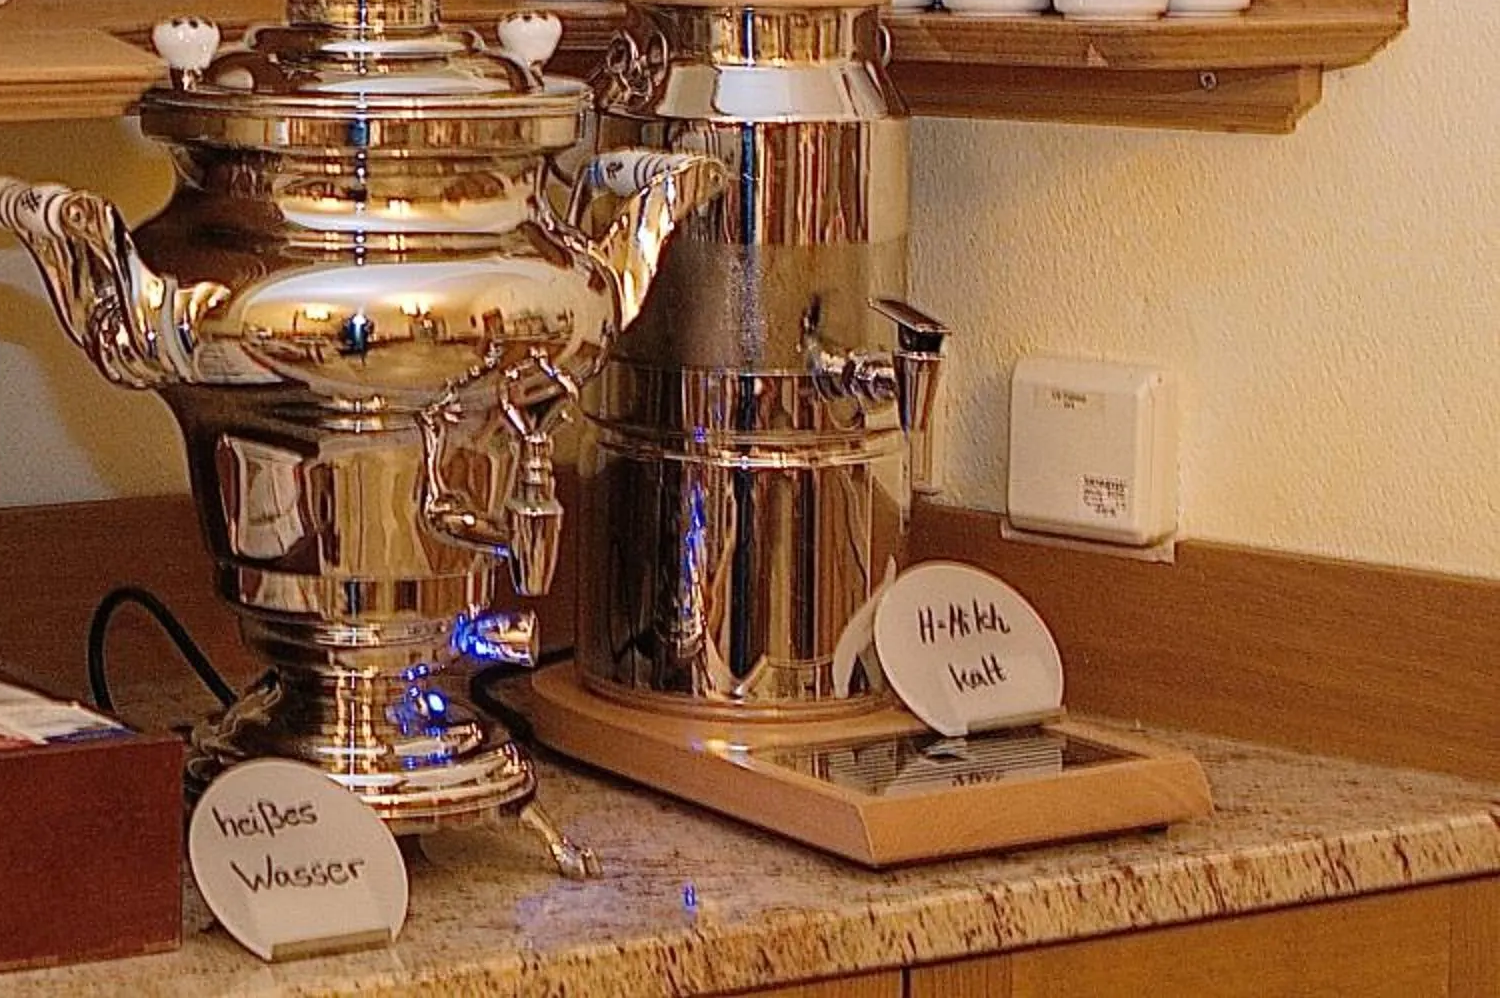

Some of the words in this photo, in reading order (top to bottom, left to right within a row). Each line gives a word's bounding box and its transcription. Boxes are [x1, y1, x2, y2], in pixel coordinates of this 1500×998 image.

[917, 598, 1011, 643] H-Milch
[948, 653, 1007, 692] kalt
[211, 799, 318, 838] heißes
[229, 854, 365, 893] Wasser
